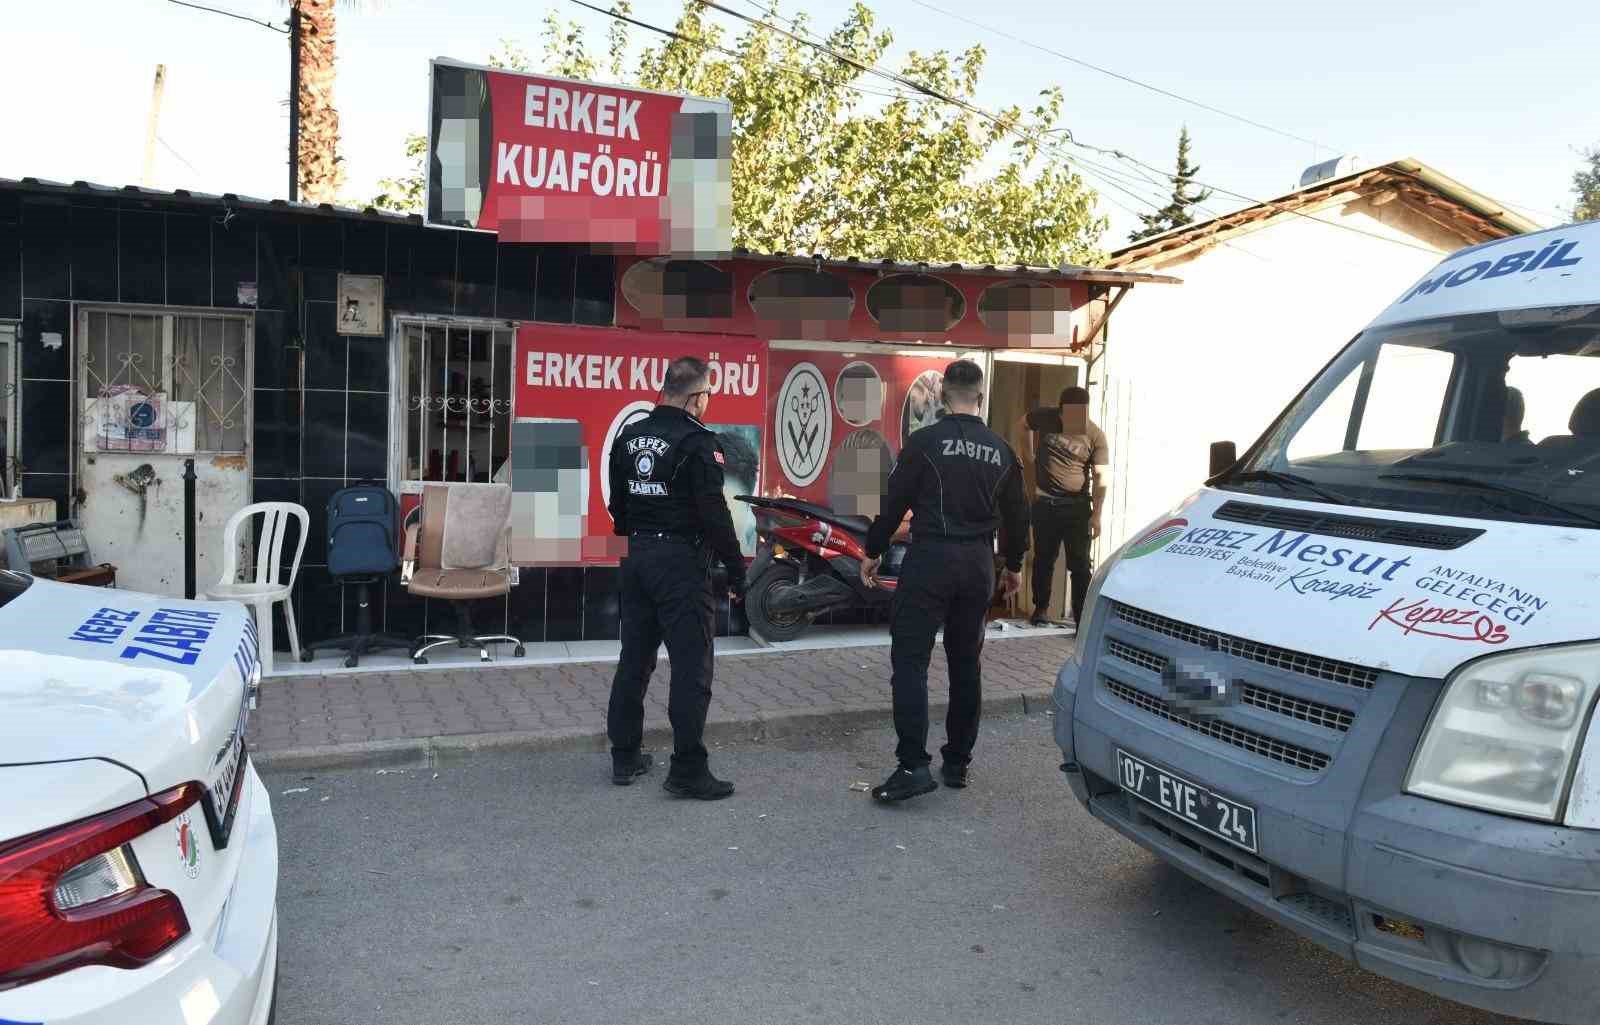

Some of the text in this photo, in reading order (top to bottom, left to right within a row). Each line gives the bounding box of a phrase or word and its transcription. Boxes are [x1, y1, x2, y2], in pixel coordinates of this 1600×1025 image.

[524, 84, 642, 141] ERKEK
[496, 142, 662, 197] KUAFÖRÜ
[1400, 238, 1583, 304] MOBİL
[526, 351, 760, 396] ERKEK KUÖRÜ
[629, 436, 668, 456] KEPEZ
[942, 439, 1002, 466] ZABITA
[629, 482, 666, 494] ZABITA
[1179, 527, 1259, 549] KEPEZ
[1252, 530, 1412, 581] Mesut
[1225, 565, 1277, 583] Başkanı
[1237, 555, 1287, 574] Belediye
[1275, 567, 1382, 601] Kocagöz
[1415, 576, 1536, 626] GELECEĞİ
[1429, 565, 1549, 611] ANTALYA'NIN
[67, 607, 141, 644] KEPEZ
[119, 608, 221, 665] ZABITA
[1367, 597, 1480, 637] Kepez
[1124, 758, 1247, 842] 07 EYE 24
